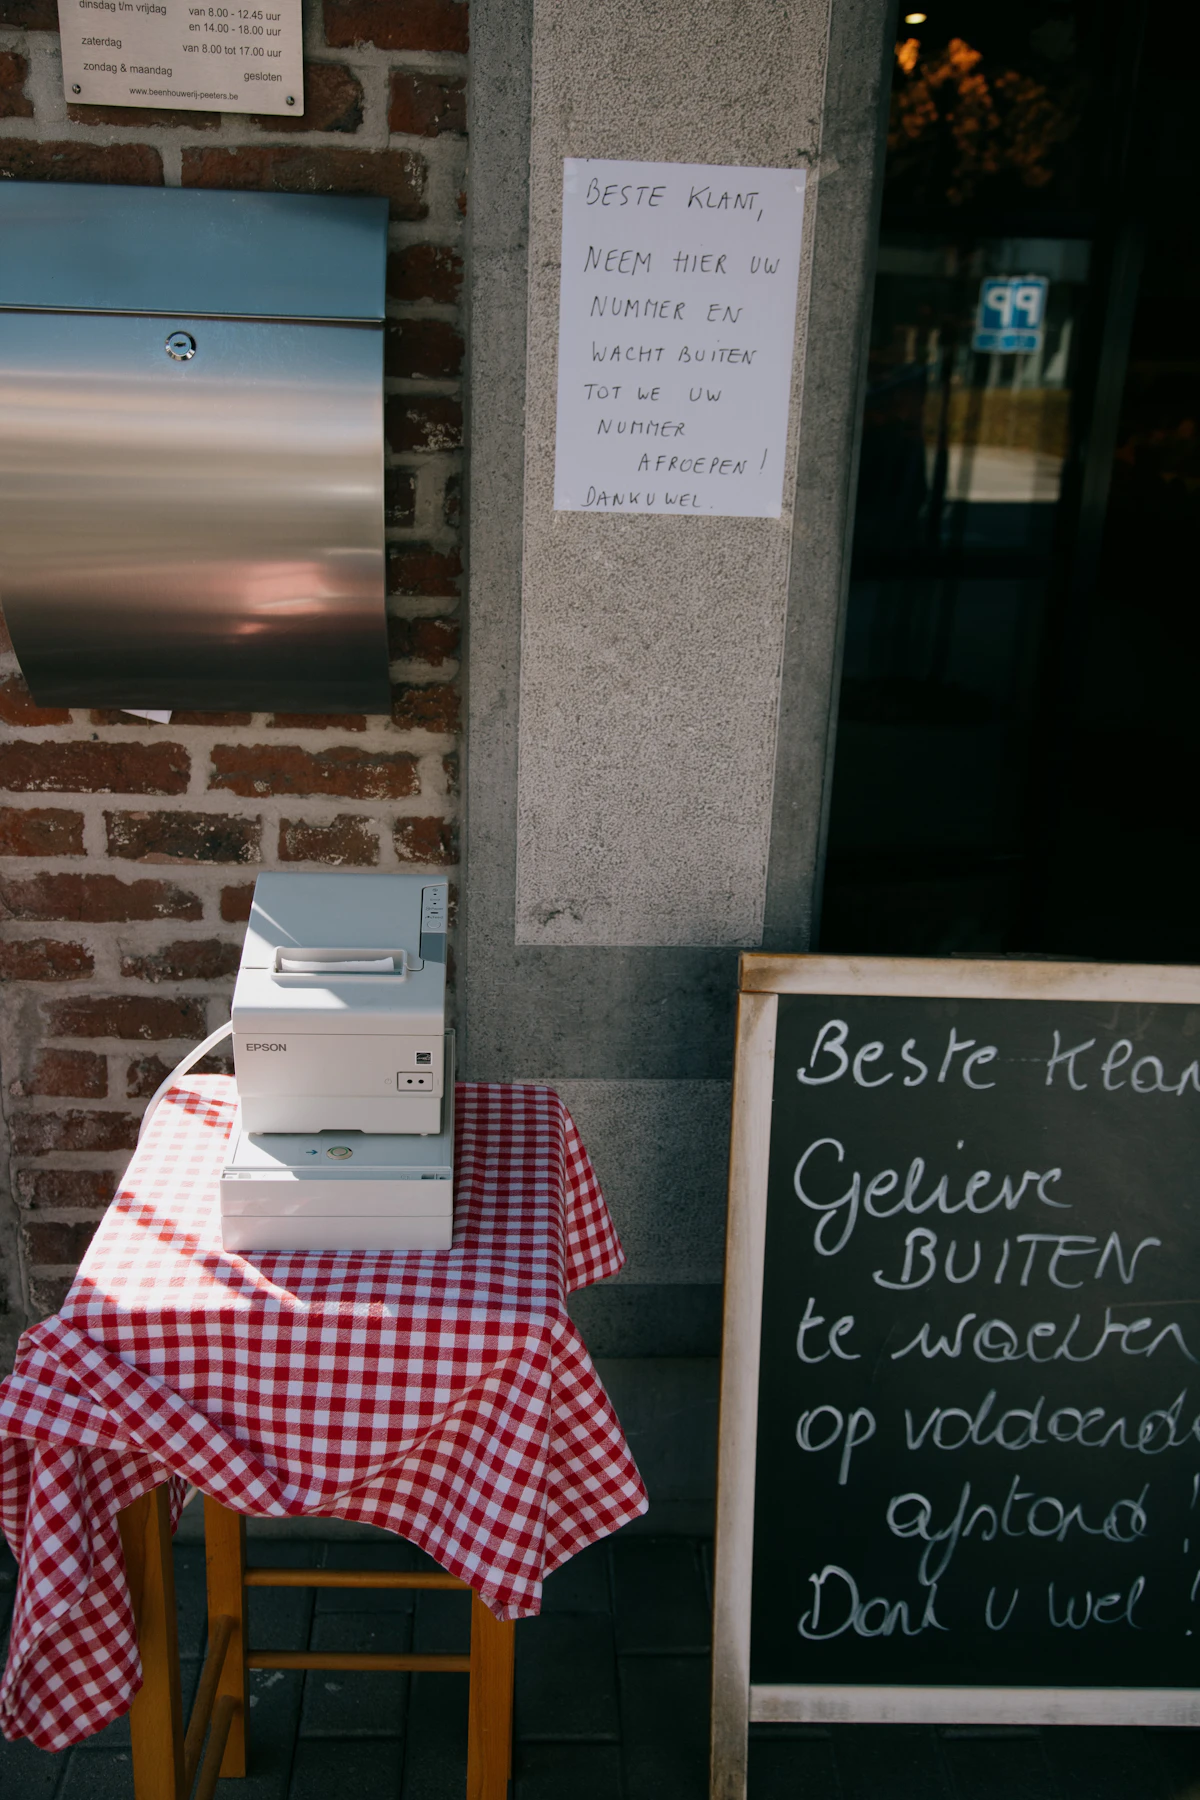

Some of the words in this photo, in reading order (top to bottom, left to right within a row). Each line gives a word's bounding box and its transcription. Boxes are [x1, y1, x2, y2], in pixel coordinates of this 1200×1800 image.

[79, 0, 116, 12] dinsdag
[118, 2, 134, 12] t/m
[136, 3, 167, 16] vrijdag
[189, 8, 206, 16] van
[208, 8, 229, 17] 8.00
[238, 9, 264, 20] 12.45
[266, 13, 281, 21] uur
[189, 23, 201, 32] en
[204, 23, 229, 33] 14.00
[239, 25, 264, 35] 18.00
[266, 28, 281, 36] uur
[81, 37, 122, 49] zaterdag
[182, 45, 200, 53] van
[202, 44, 222, 54] 8.00
[224, 46, 237, 55] tot
[240, 47, 264, 57] 17.00
[83, 62, 118, 74] zondag
[120, 63, 127, 72] &
[130, 65, 173, 77] maandag
[244, 72, 283, 82] gesloten
[129, 87, 239, 101] www.beenhouwerij-peeters.be
[586, 177, 667, 207] BESTE
[687, 186, 764, 222] KLANT,
[583, 245, 652, 276] NEEM
[673, 250, 727, 275] HIER
[750, 255, 781, 275] UW
[590, 295, 686, 321] NUMMER
[706, 303, 744, 324] EN
[592, 341, 666, 363] WACHT
[584, 384, 622, 400] TOT
[637, 387, 661, 401] WE
[689, 387, 722, 402] UW
[597, 419, 686, 437] NUMMER
[637, 453, 748, 475] AFROEPEN
[246, 1043, 287, 1052] EPSON
[796, 1018, 999, 1090] Beste
[872, 1226, 1162, 1291] BUITEN
[796, 1297, 861, 1364] te
[795, 1404, 877, 1485] op
[886, 1474, 1150, 1586] afstand
[797, 1564, 950, 1640] Dank
